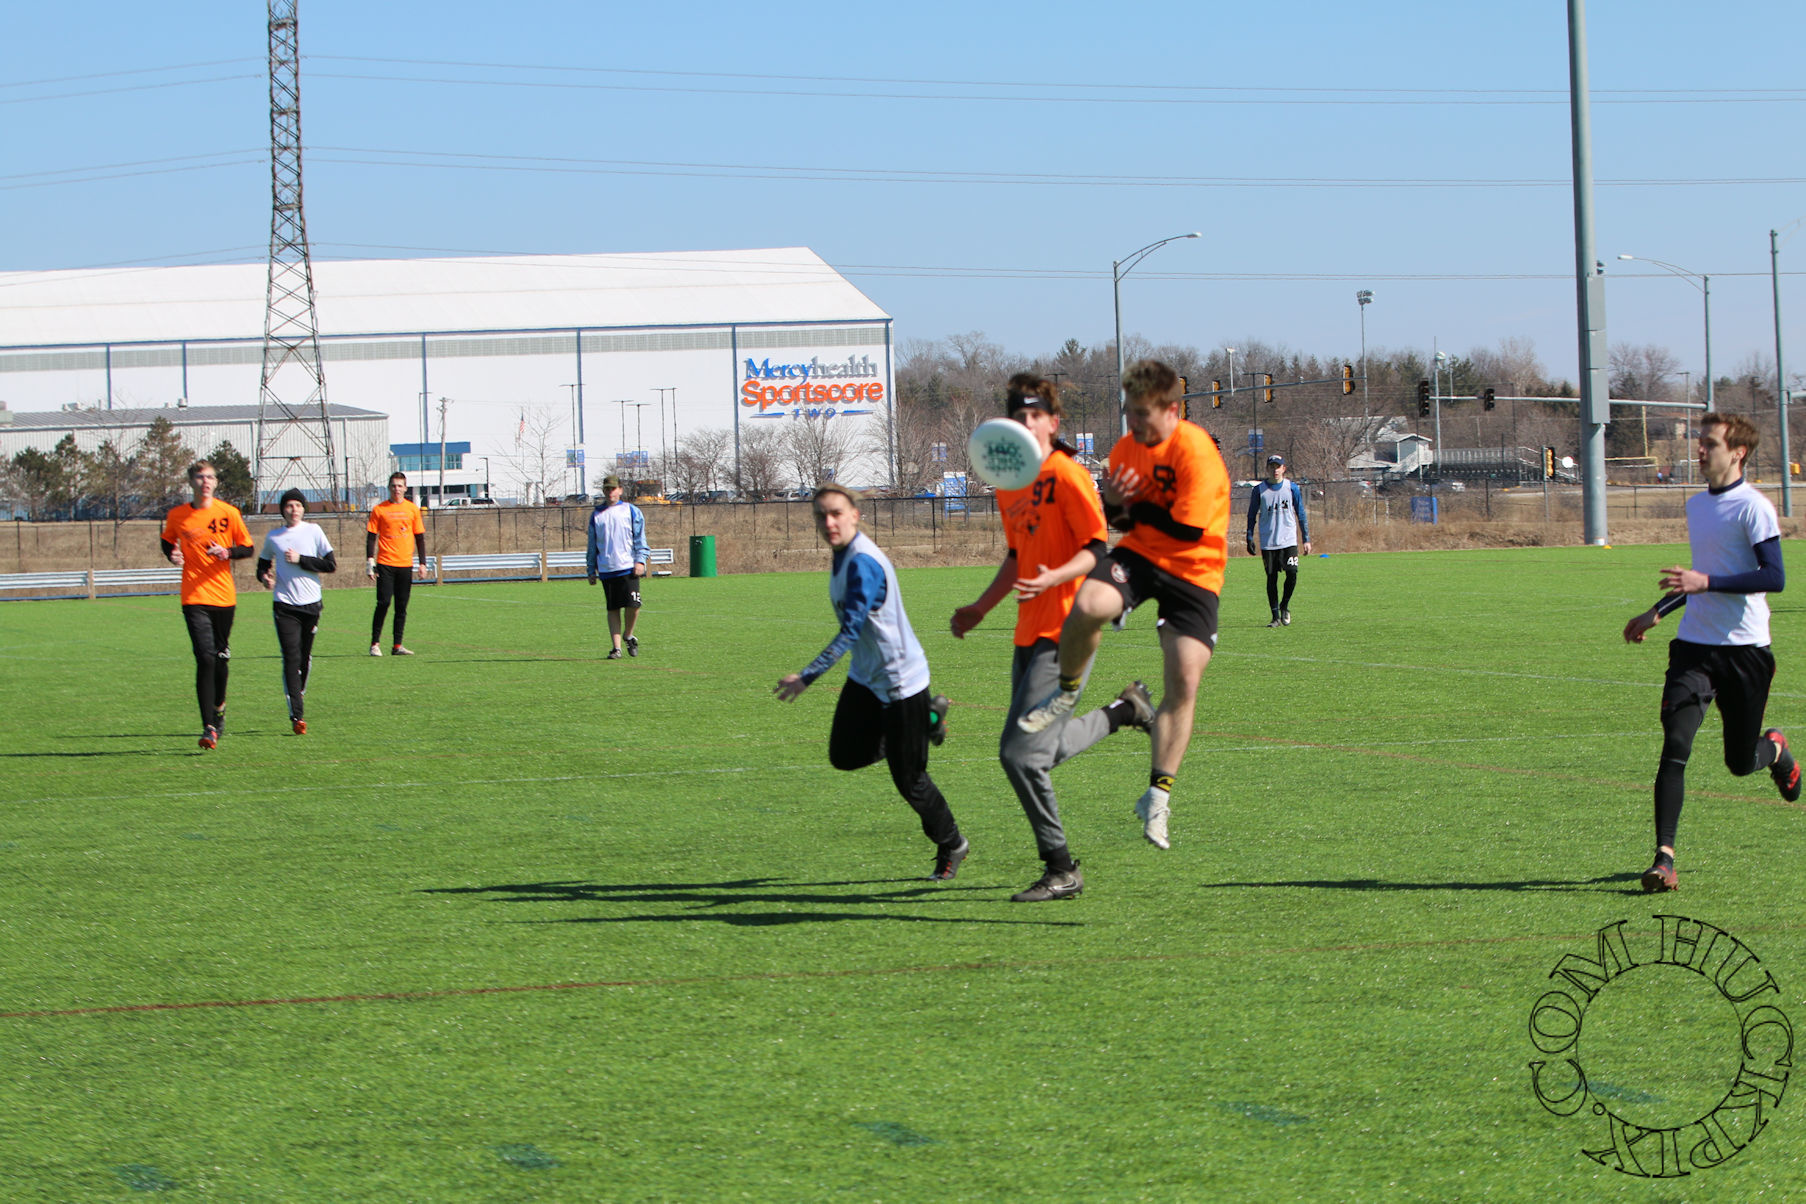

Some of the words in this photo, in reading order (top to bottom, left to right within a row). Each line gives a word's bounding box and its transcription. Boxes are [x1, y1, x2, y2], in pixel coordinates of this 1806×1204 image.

[745, 354, 877, 385] Mercyhealth
[743, 380, 884, 409] Sportscore
[792, 408, 837, 419] TWO
[1032, 477, 1056, 507] 97
[207, 517, 229, 534] 49
[1287, 557, 1299, 567] 42
